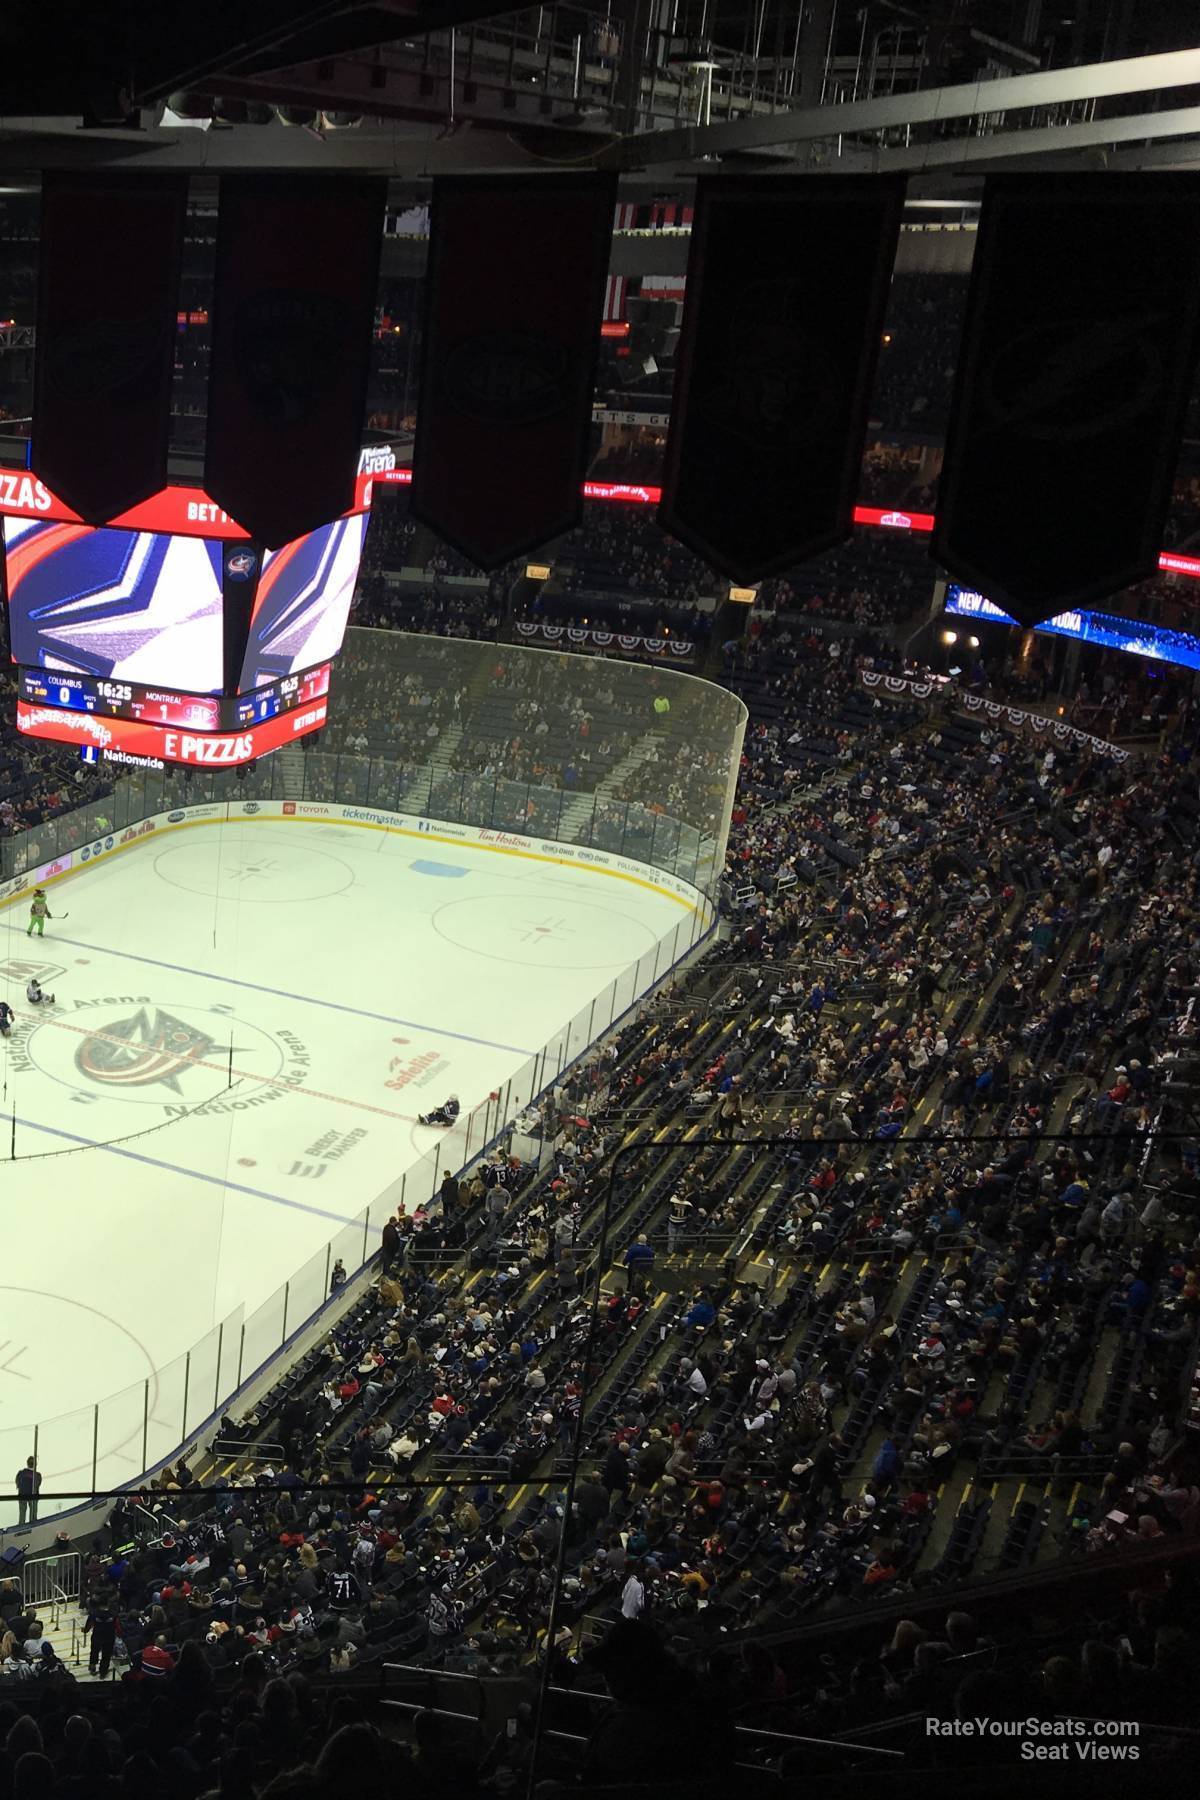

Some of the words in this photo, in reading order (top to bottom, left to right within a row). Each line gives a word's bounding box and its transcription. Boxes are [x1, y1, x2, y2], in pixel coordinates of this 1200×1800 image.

[958, 591, 982, 613] NEW
[48, 676, 82, 689] COLUMBUS
[96, 681, 132, 701] 16:25
[59, 687, 70, 704] 0
[145, 691, 182, 705] MONTREAL
[111, 705, 117, 714] 1
[159, 704, 168, 721] 1
[260, 700, 267, 717] 0
[164, 733, 178, 757] E
[181, 734, 254, 763] PIZZAS
[103, 748, 165, 770] Nationwide
[299, 806, 329, 814] TOYOTA
[342, 807, 405, 827] ticketmaster
[431, 825, 466, 837] Nationwide
[478, 828, 495, 841] Tim
[495, 831, 532, 849] Hortons
[617, 862, 641, 873] FOLLOW
[5, 1005, 68, 1073] Nationwide
[72, 994, 152, 1009] Arena
[276, 1030, 313, 1067] Arena
[384, 1051, 440, 1091] Safelite
[163, 1068, 309, 1117] Nationwide
[304, 1128, 346, 1157] ENERGY
[321, 1127, 369, 1161] TRANSFER
[333, 1580, 350, 1599] 71
